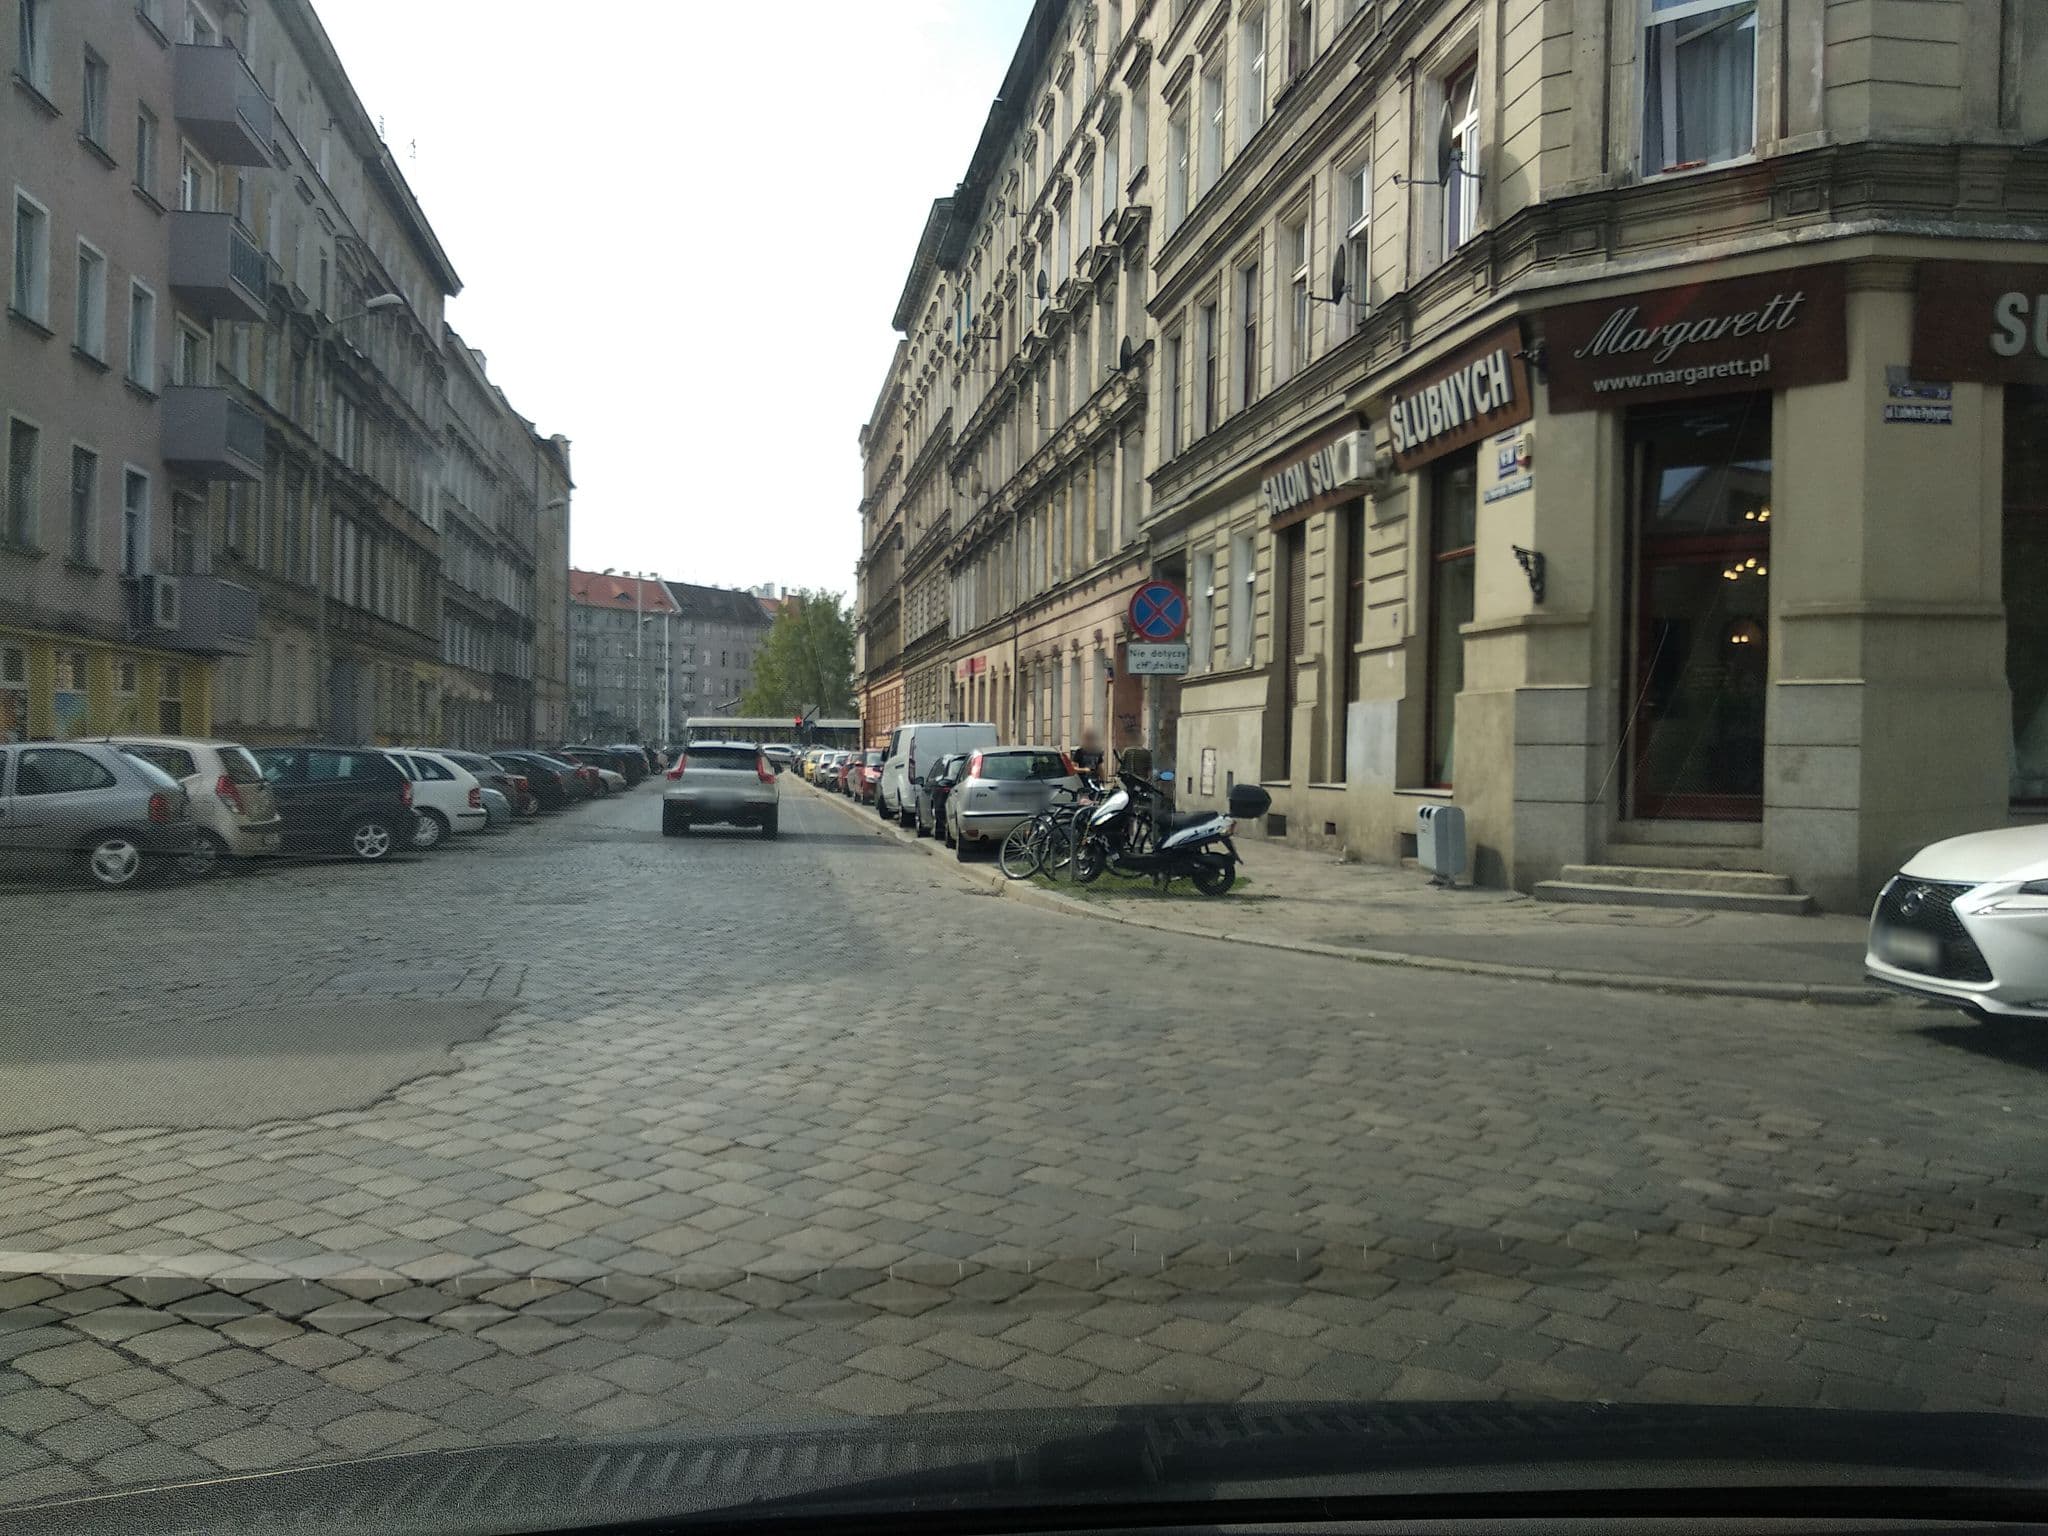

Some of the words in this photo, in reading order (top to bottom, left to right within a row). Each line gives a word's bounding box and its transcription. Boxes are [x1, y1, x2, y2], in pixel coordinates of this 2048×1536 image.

[1574, 291, 1805, 364] Margarett
[1593, 353, 1771, 393] www.margarett.pl
[1262, 461, 1310, 520] SALON
[1308, 444, 1337, 496] SU
[1389, 348, 1512, 454] ŚLUBNYCH
[1129, 649, 1146, 658] Nie
[1151, 649, 1186, 659] dotyczy
